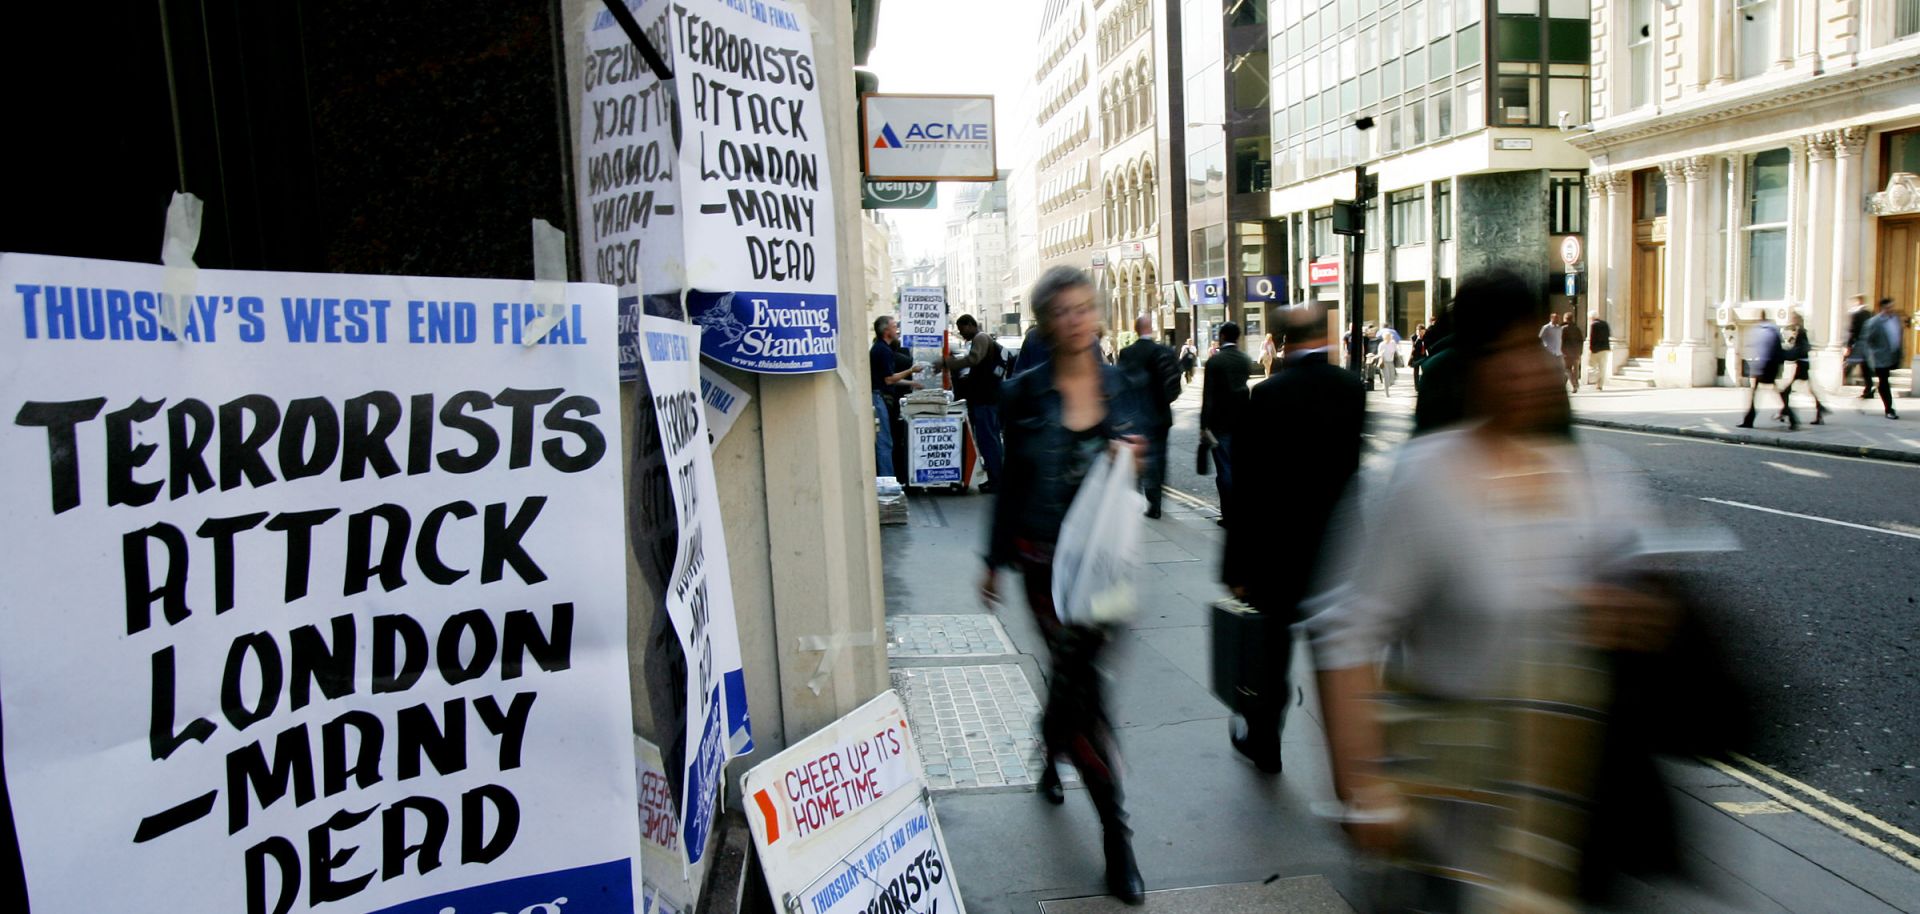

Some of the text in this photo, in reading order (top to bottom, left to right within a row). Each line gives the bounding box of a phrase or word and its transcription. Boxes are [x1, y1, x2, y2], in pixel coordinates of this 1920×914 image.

[673, 2, 815, 91] TERRORISTS
[768, 6, 800, 32] FINAL
[693, 72, 808, 142] ATTACK
[905, 122, 988, 139] ACME
[700, 131, 819, 192] LONDON
[700, 189, 815, 237] -MANY
[746, 235, 815, 283] DEAD
[281, 297, 391, 343] WEST
[408, 300, 477, 344] END
[736, 329, 838, 357] Standard
[748, 299, 831, 333] Evening
[707, 383, 736, 414] FINAL
[13, 387, 608, 515] TERRORISTS
[122, 496, 548, 636] ATTACK
[149, 602, 574, 761] LONDON
[132, 691, 537, 844] -MANY
[785, 727, 901, 802] CHEER UP ITS
[244, 783, 521, 914] DEAD
[811, 860, 866, 914] THURSDAY'S
[865, 841, 891, 874] WEST
[890, 827, 906, 854] END
